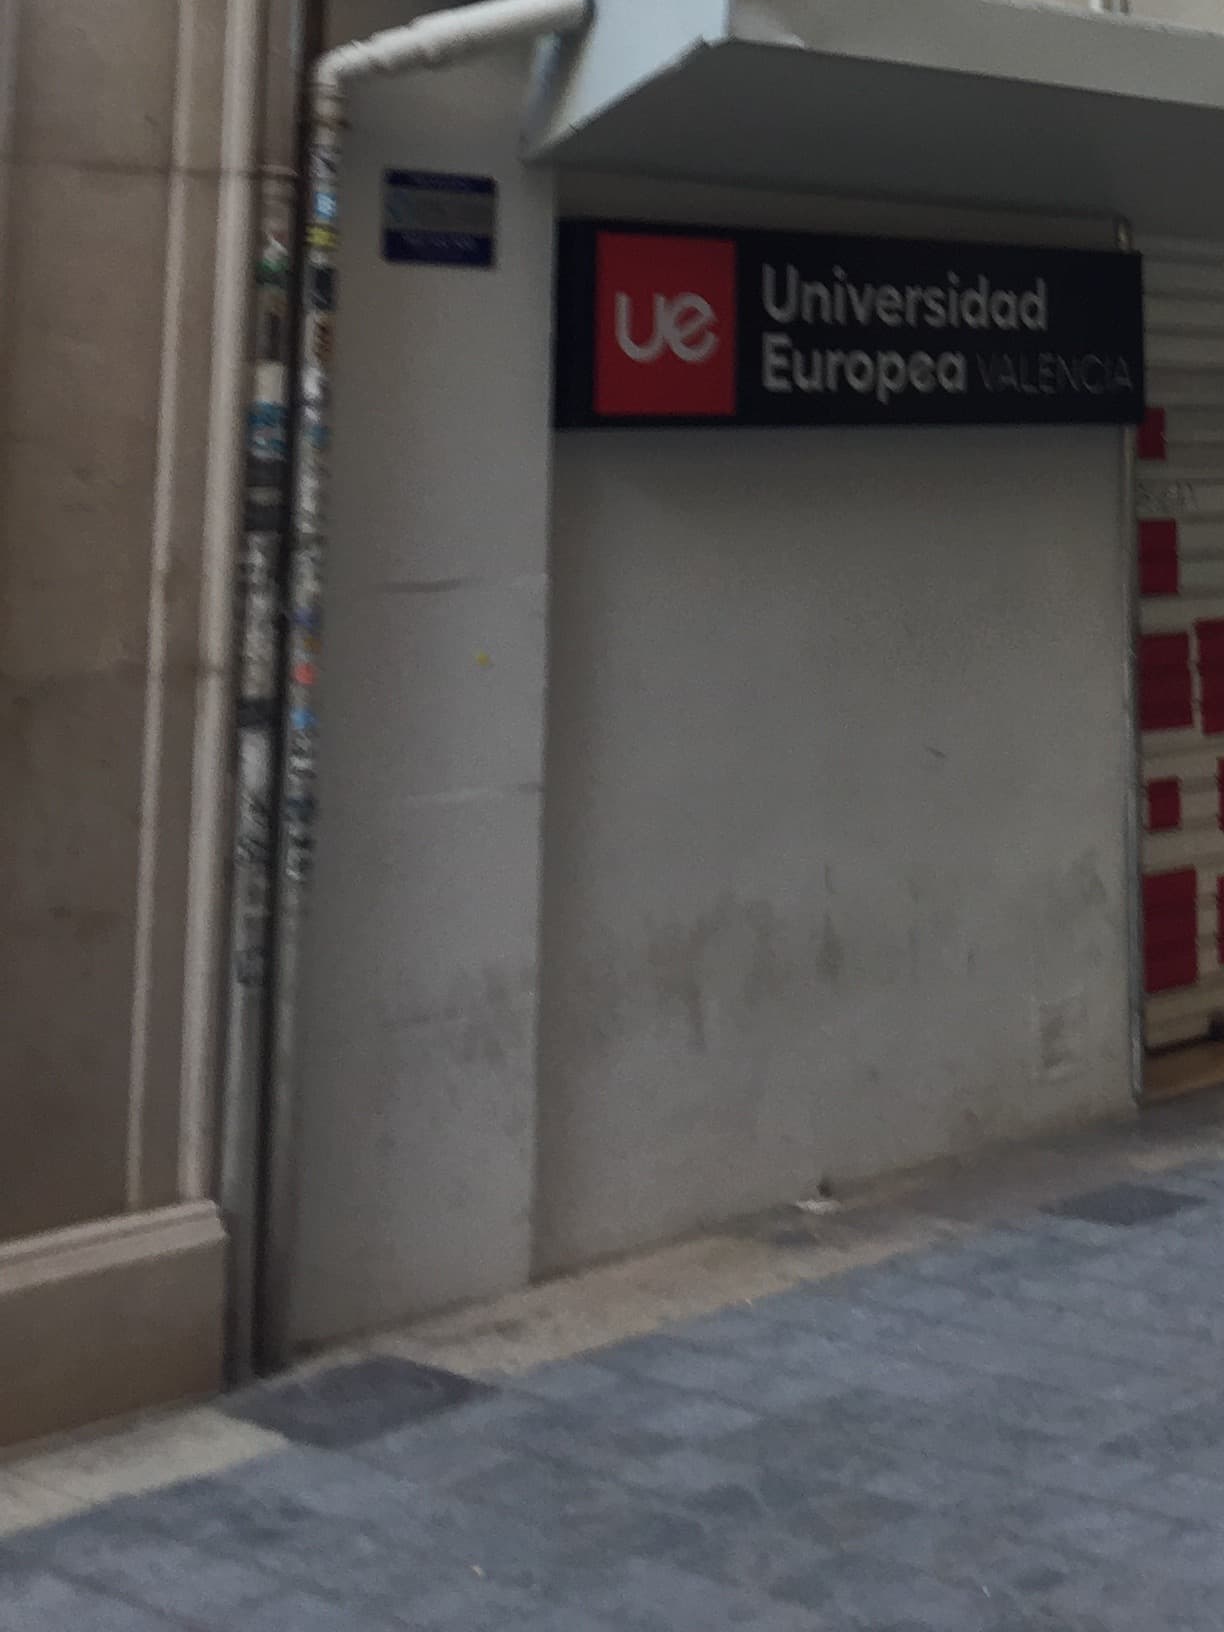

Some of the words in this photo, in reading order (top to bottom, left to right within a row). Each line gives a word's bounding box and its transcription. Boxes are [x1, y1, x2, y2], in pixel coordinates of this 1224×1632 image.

[761, 263, 1048, 331] Universidad
[761, 332, 967, 404] Europea
[975, 352, 1134, 394] VALENCIA
